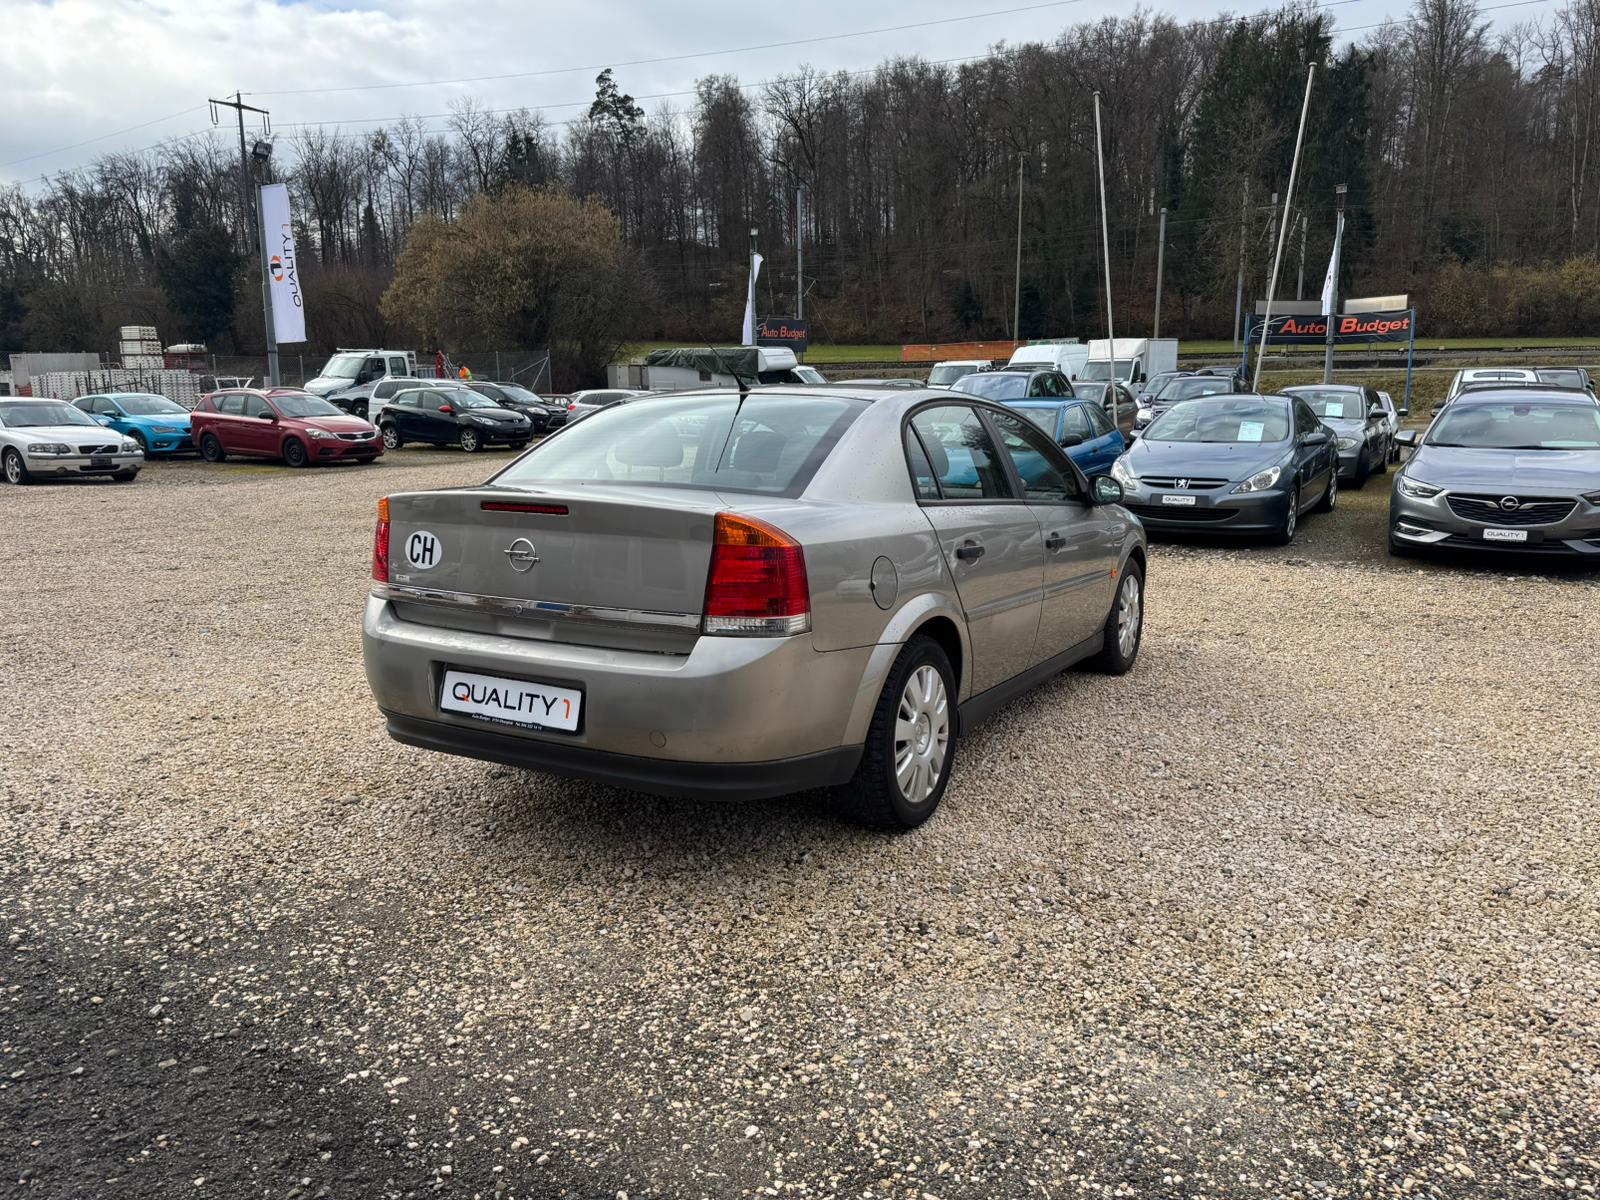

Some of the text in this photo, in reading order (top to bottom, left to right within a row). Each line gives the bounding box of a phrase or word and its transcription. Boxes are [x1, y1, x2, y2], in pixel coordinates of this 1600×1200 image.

[282, 233, 301, 307] QUALITY
[761, 325, 805, 340] Auto Budget
[1279, 318, 1410, 335] Auto Budget
[410, 534, 435, 566] CH
[452, 682, 571, 720] QUALITY 1
